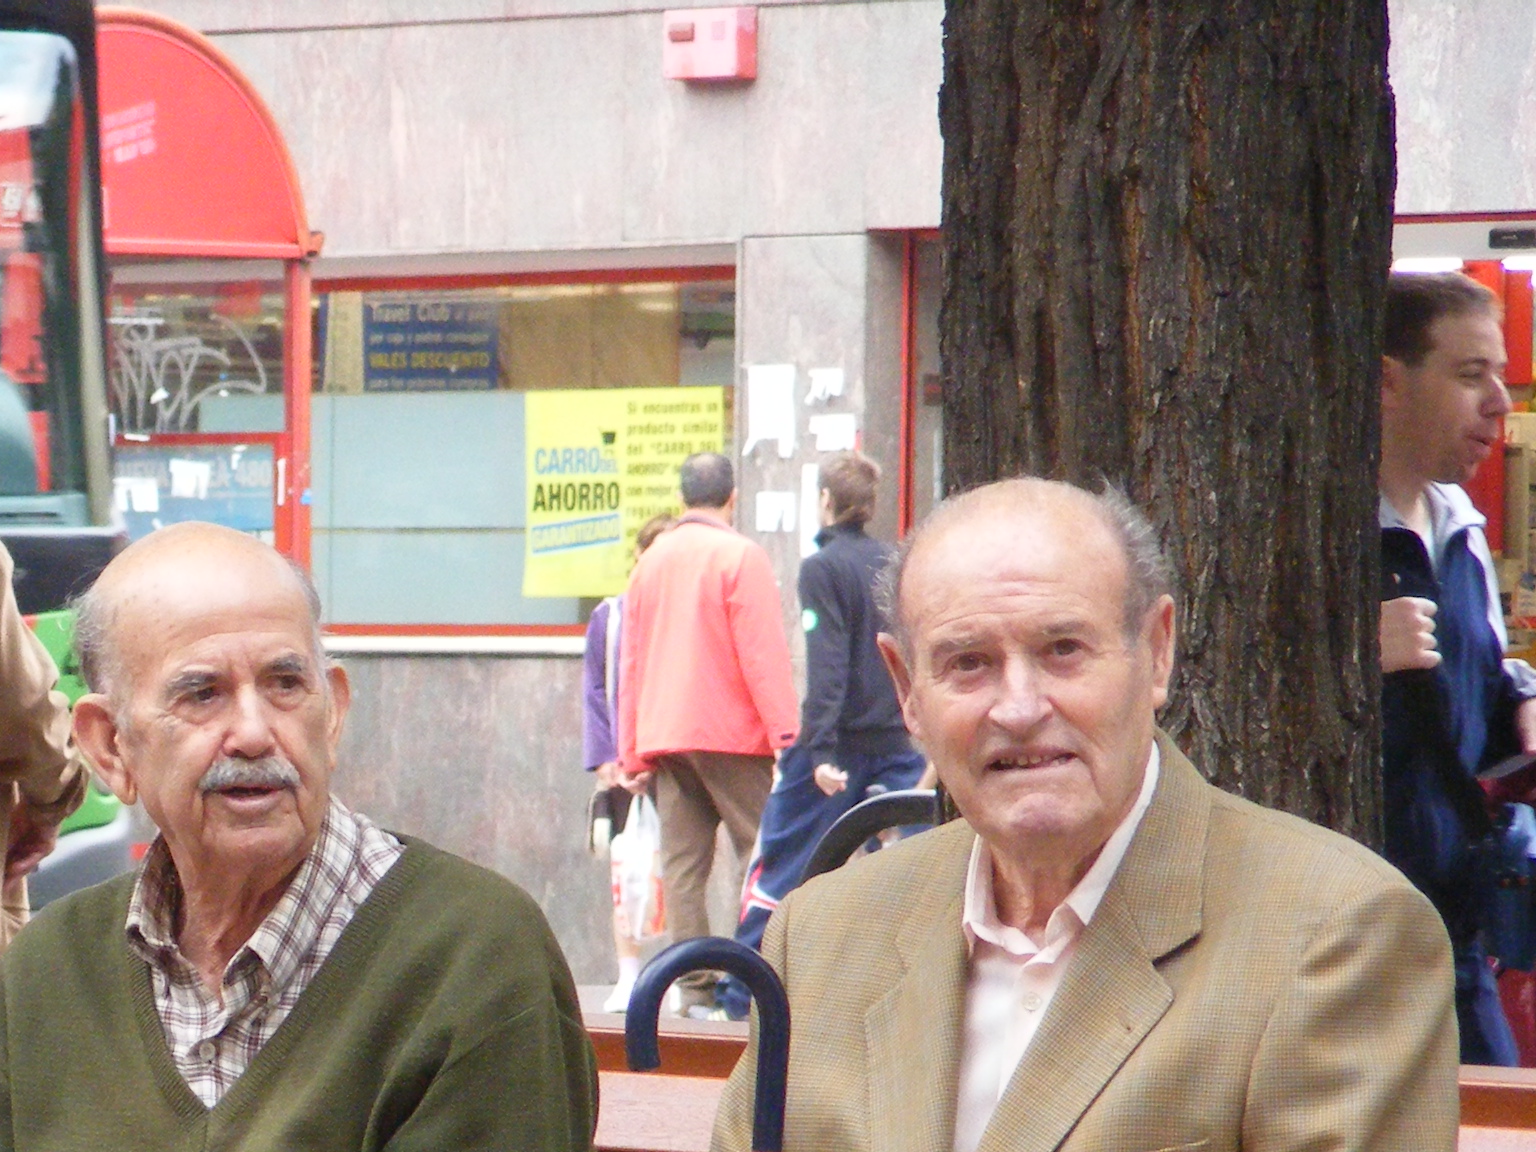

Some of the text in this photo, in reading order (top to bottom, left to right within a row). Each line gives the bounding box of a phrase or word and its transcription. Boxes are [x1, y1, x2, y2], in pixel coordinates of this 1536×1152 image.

[369, 351, 490, 369] VALES DESCUENTO
[627, 401, 636, 415] Si
[643, 402, 701, 414] encuentras
[626, 421, 718, 437] producto similar
[626, 443, 642, 456] del
[534, 448, 600, 475] CARRO
[533, 482, 620, 512] AHORRO
[532, 517, 620, 550] GARANTIZADO
